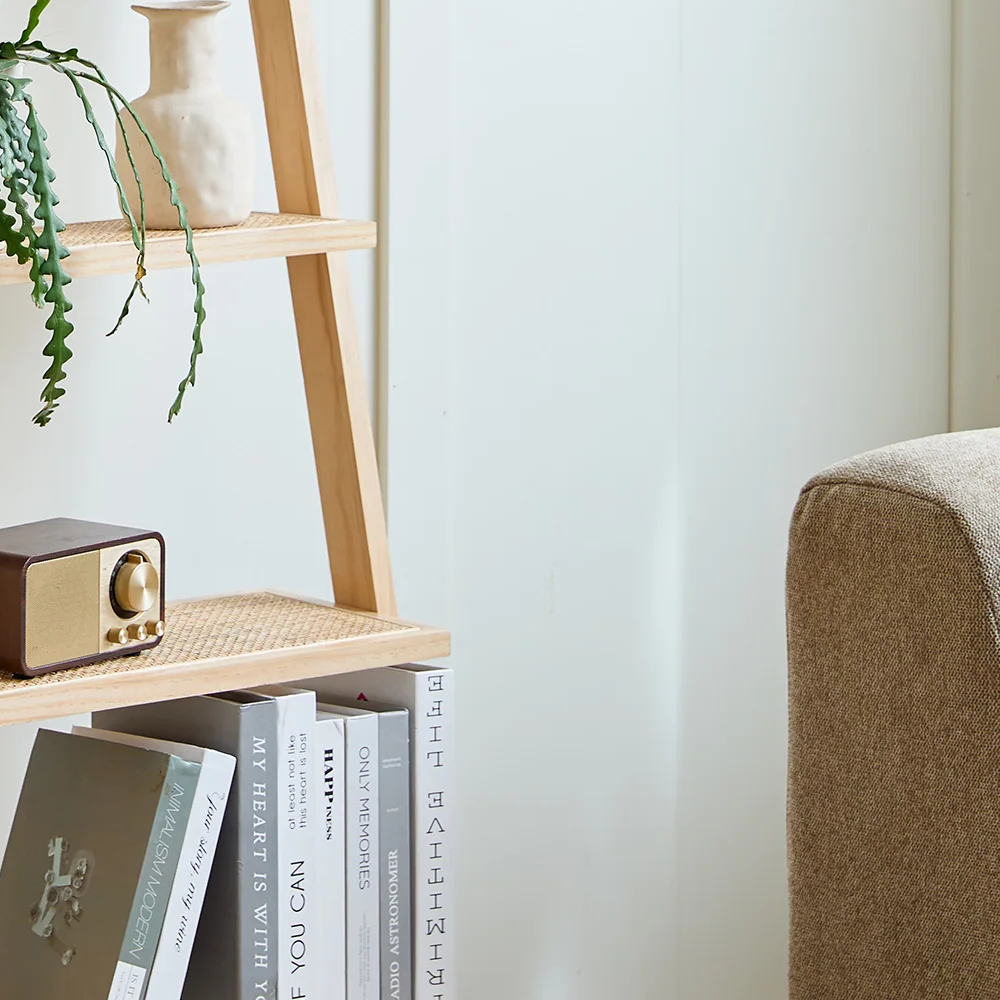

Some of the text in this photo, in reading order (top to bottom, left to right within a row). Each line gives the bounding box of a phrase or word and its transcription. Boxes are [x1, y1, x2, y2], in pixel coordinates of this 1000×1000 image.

[426, 675, 445, 767] LIFE
[204, 791, 226, 833] Your
[288, 735, 296, 830] at least not like
[299, 733, 307, 828] this heart is lost
[358, 746, 370, 890] ONLY MEMORIES
[181, 882, 196, 910] my
[253, 736, 268, 1000] MY HEART IS WITH Y
[290, 860, 306, 912] CAN
[388, 848, 400, 955] ASTRONOMER
[129, 875, 161, 960] MODERN
[174, 915, 188, 953] wine
[290, 923, 306, 974] YOU
